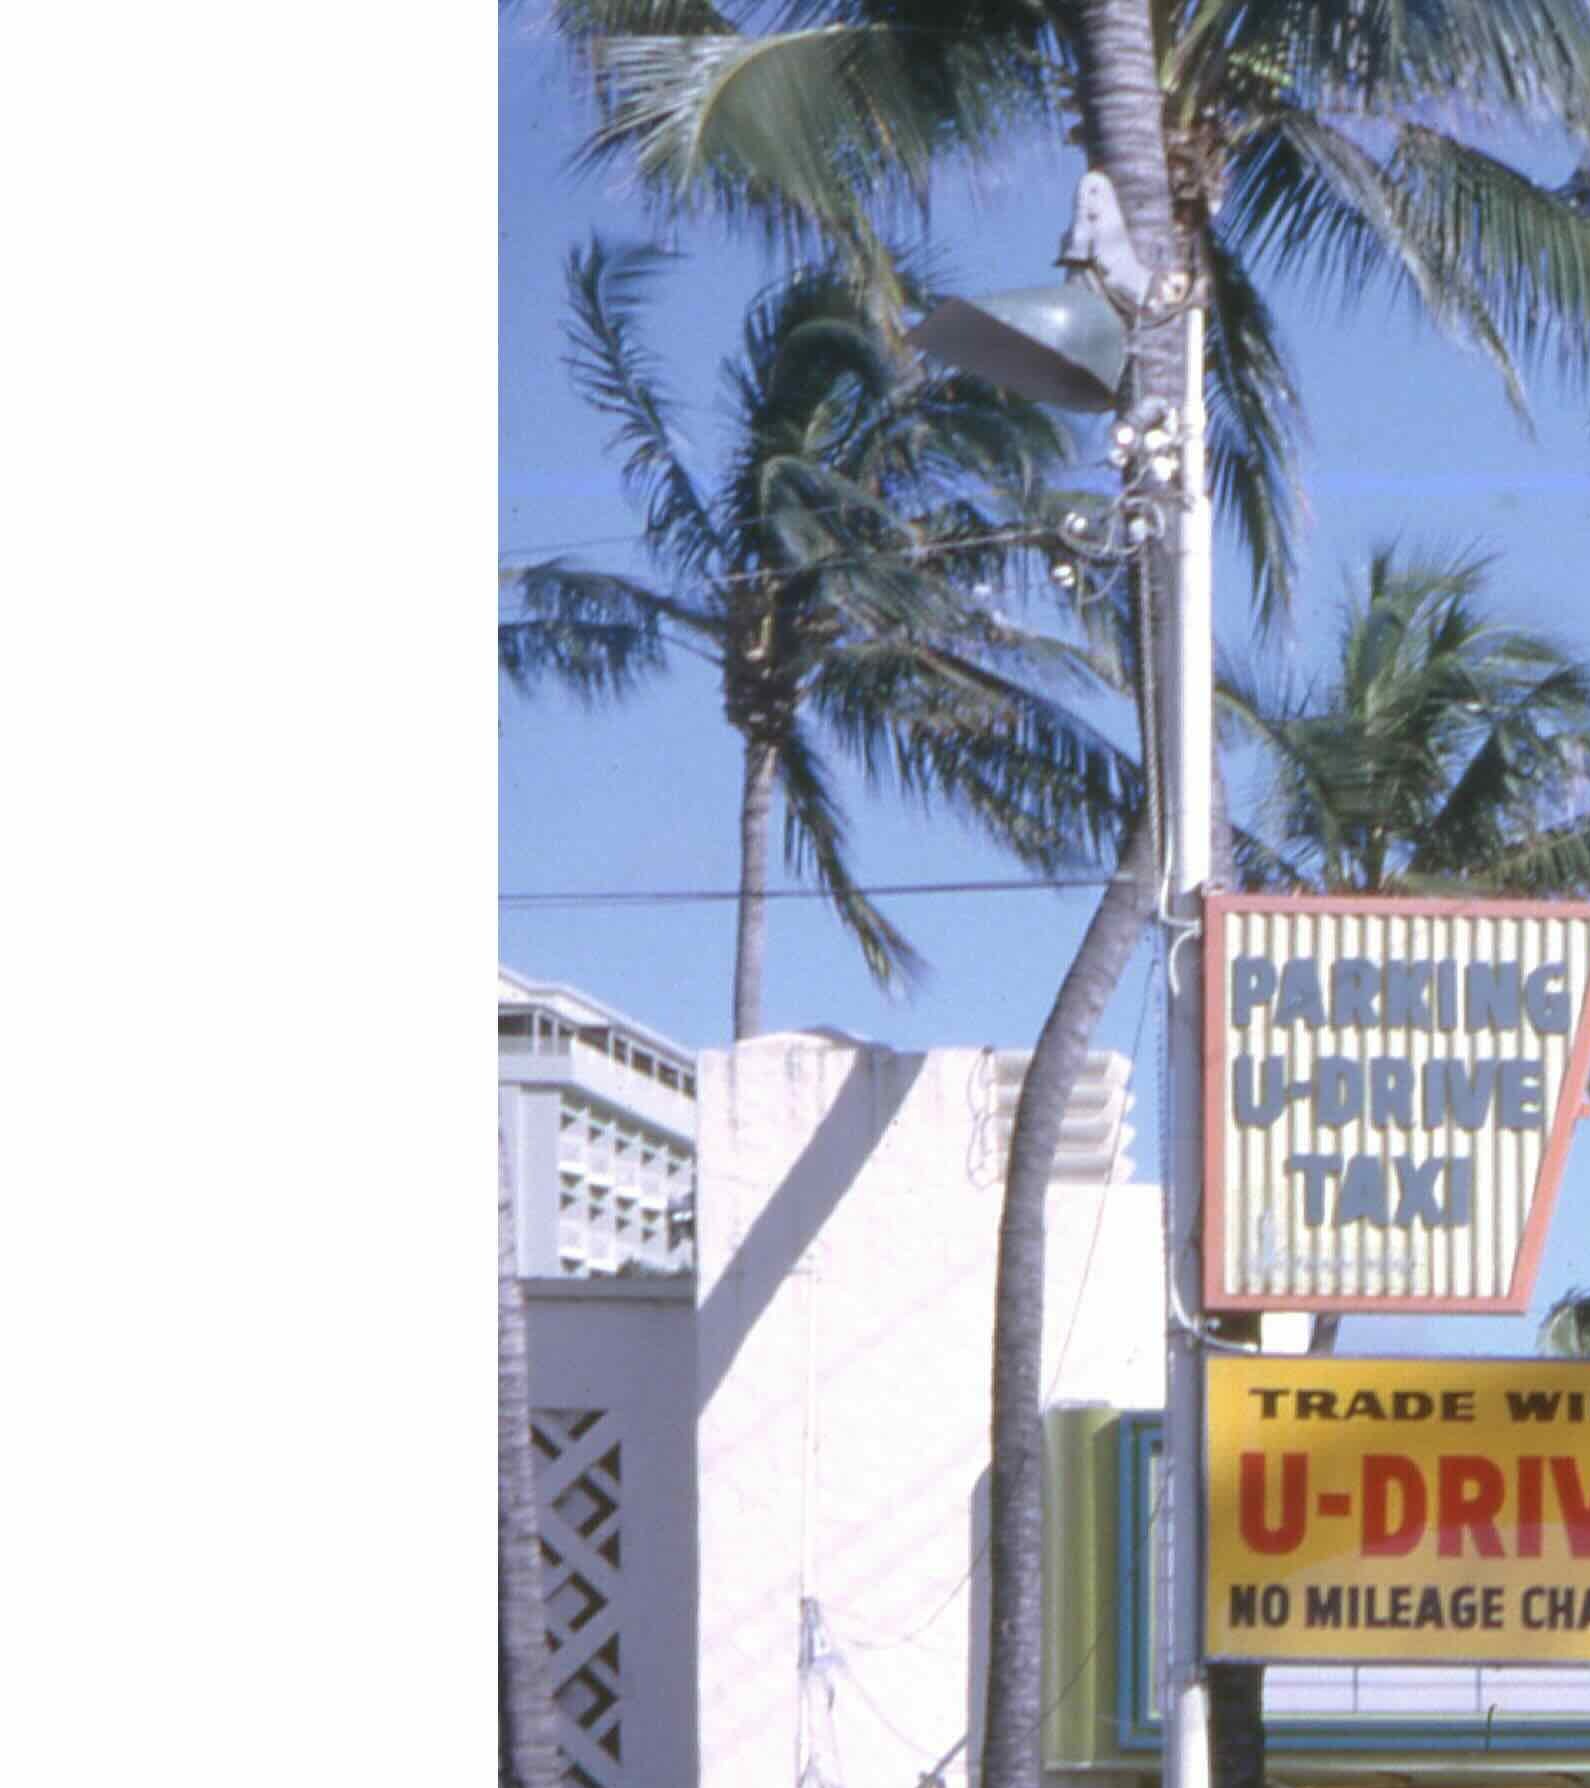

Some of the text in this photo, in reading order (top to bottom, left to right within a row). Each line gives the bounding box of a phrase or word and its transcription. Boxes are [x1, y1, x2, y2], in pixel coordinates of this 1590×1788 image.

[1231, 956, 1572, 1035] PARKING
[1232, 1055, 1547, 1131] U-DRIVE
[1284, 1153, 1473, 1230] TAXI
[1249, 1387, 1477, 1422] TRADE
[1229, 1584, 1291, 1630] NO
[1304, 1585, 1505, 1631] MILEAGE
